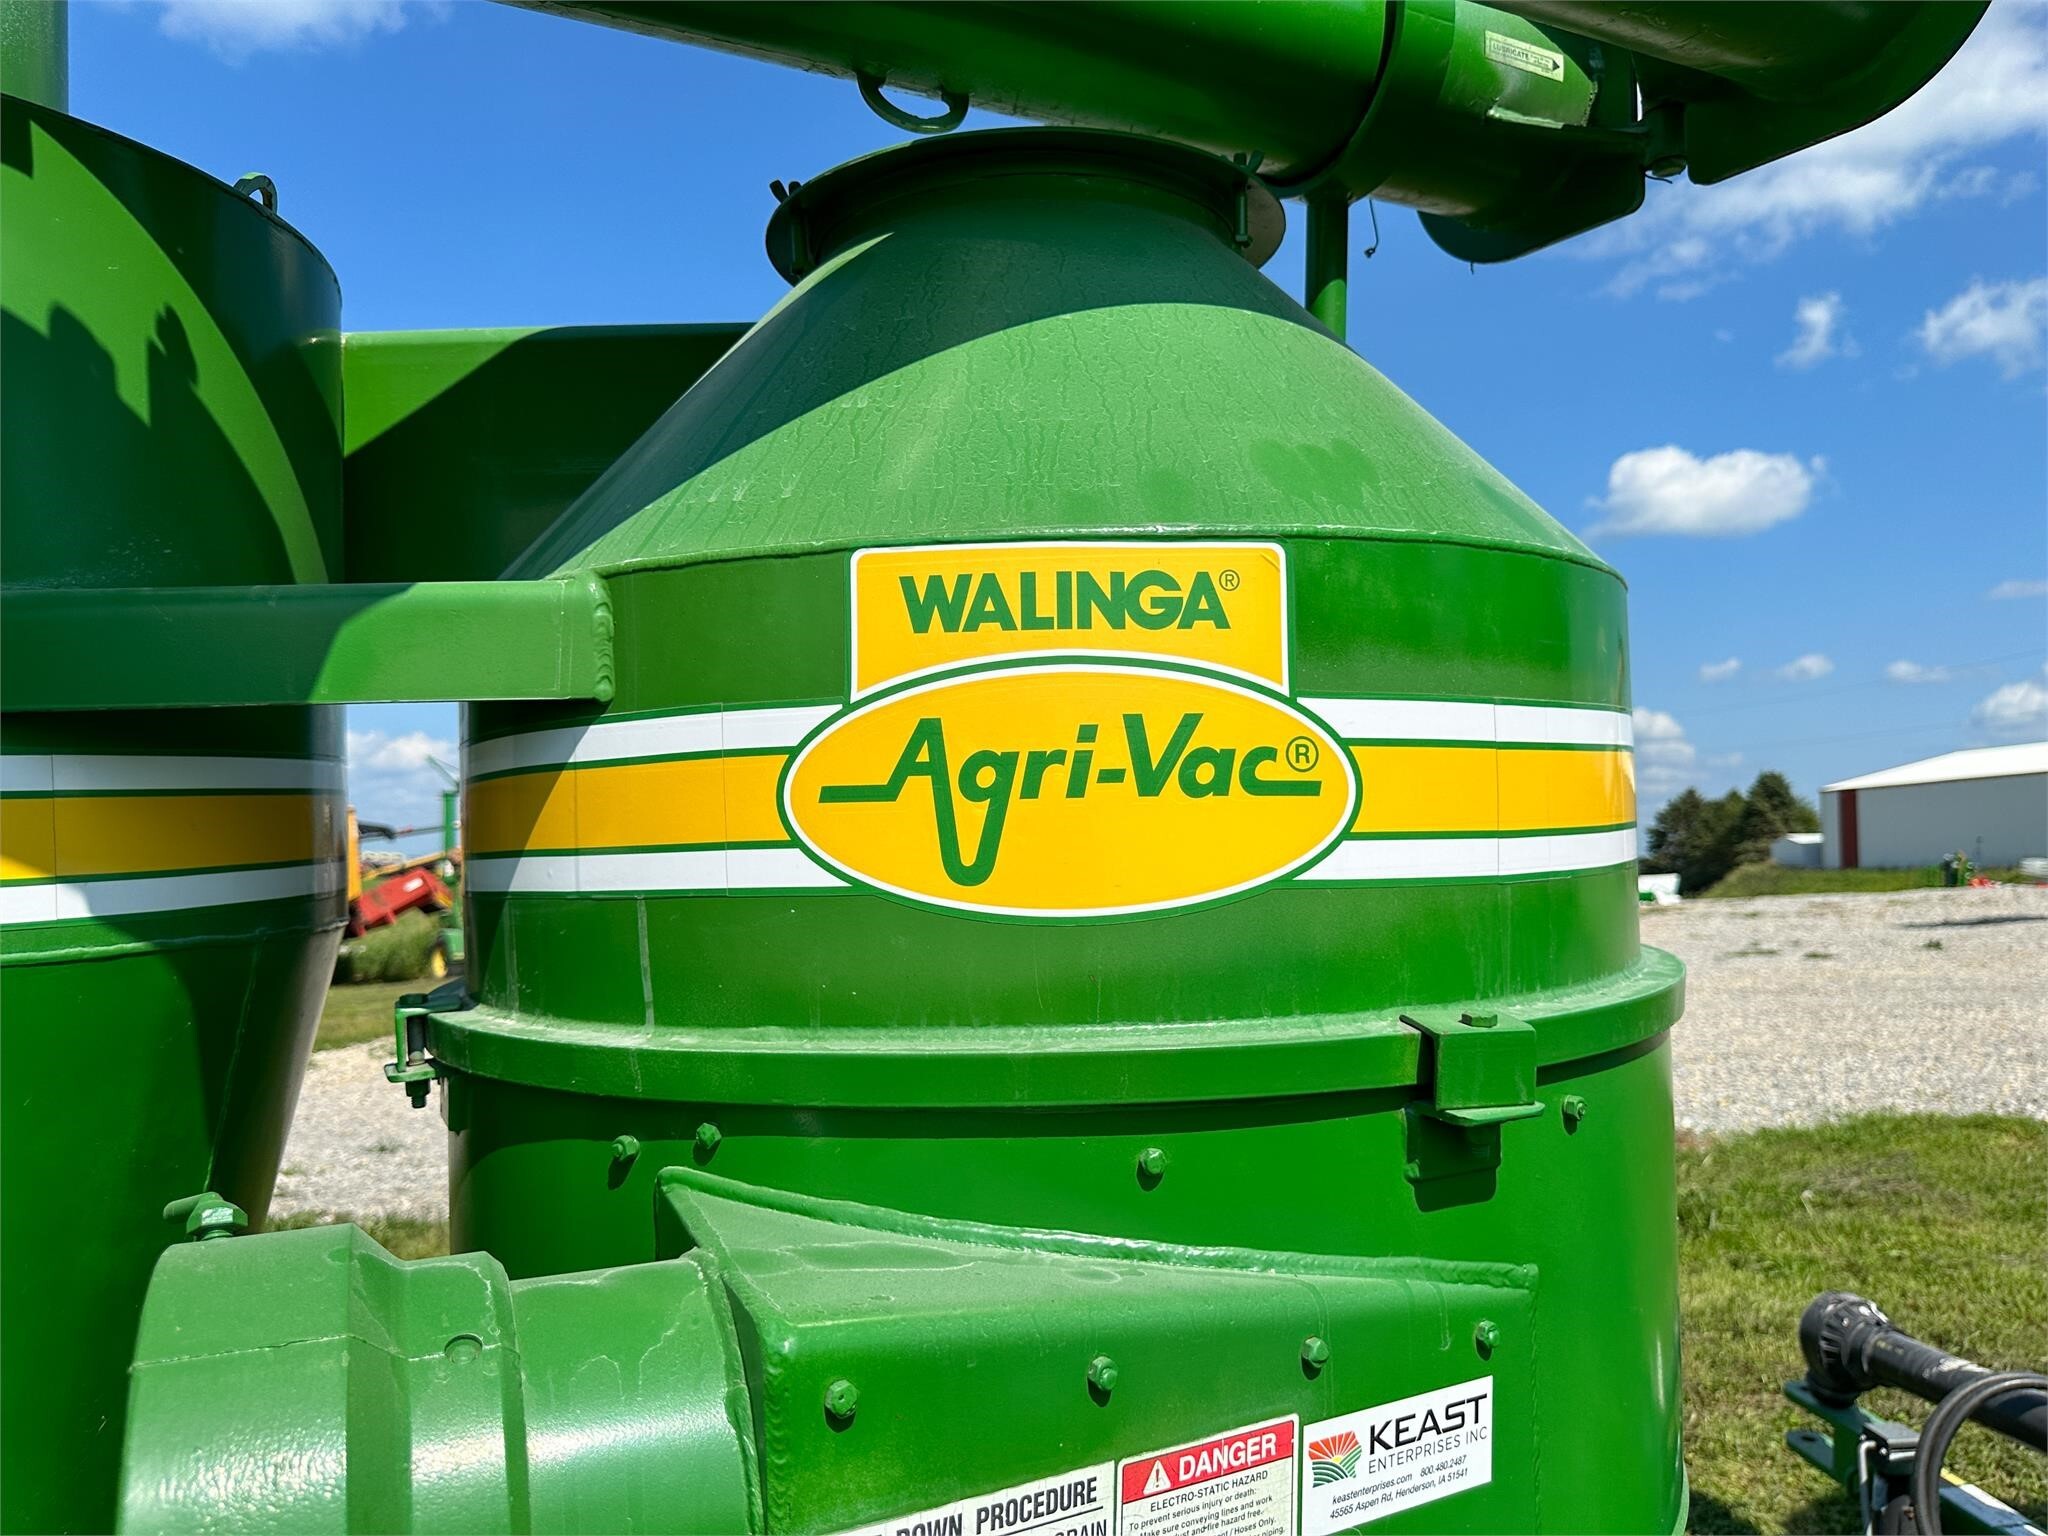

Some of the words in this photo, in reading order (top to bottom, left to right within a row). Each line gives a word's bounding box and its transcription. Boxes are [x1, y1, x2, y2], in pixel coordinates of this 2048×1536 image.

[1370, 1393, 1487, 1455] KEAST
[1178, 1432, 1277, 1482] DANGER
[1368, 1434, 1461, 1475] ENTERPRISES
[1466, 1426, 1488, 1445] INC
[1150, 1481, 1230, 1513] ELECTRO-STATIC
[1232, 1470, 1268, 1489] HAZARD
[1332, 1473, 1413, 1505] keastenterprises.com
[1420, 1454, 1467, 1477] 800.480.2487
[1355, 1498, 1379, 1512] Aspen
[1381, 1491, 1393, 1503] Rd,
[1396, 1480, 1436, 1499] Henderson,
[1447, 1467, 1468, 1483] 51541
[976, 1476, 1097, 1535] PROCEDURE
[1129, 1522, 1139, 1531] To
[1141, 1512, 1170, 1530] prevent
[1172, 1503, 1200, 1518] serious
[1202, 1496, 1223, 1510] injury
[1224, 1494, 1233, 1503] or
[1234, 1487, 1257, 1500] death:
[1162, 1523, 1180, 1535] sure
[1181, 1511, 1220, 1529] conveying
[1221, 1505, 1239, 1517] lines
[1240, 1499, 1254, 1511] and
[1256, 1494, 1273, 1506] work
[1221, 1511, 1246, 1527] hazard
[1234, 1521, 1257, 1536] Hoses
